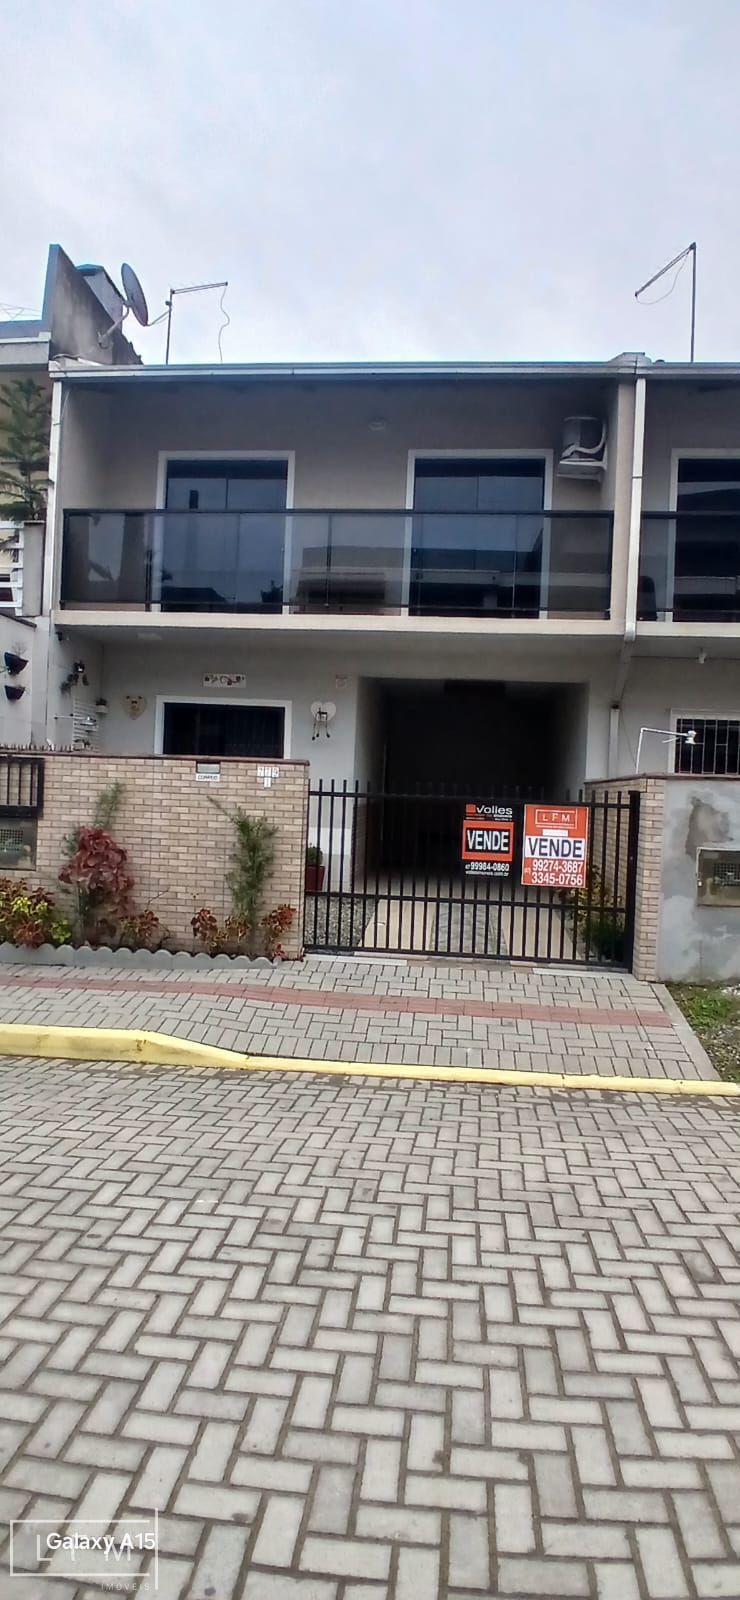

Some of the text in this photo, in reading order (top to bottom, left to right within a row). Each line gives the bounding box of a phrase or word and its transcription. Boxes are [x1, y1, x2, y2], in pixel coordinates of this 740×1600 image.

[476, 805, 513, 815] Volles
[467, 829, 509, 851] VENDE
[528, 837, 583, 858] VENDE
[532, 859, 584, 873] 99274-3687
[531, 872, 583, 885] 3345-0756
